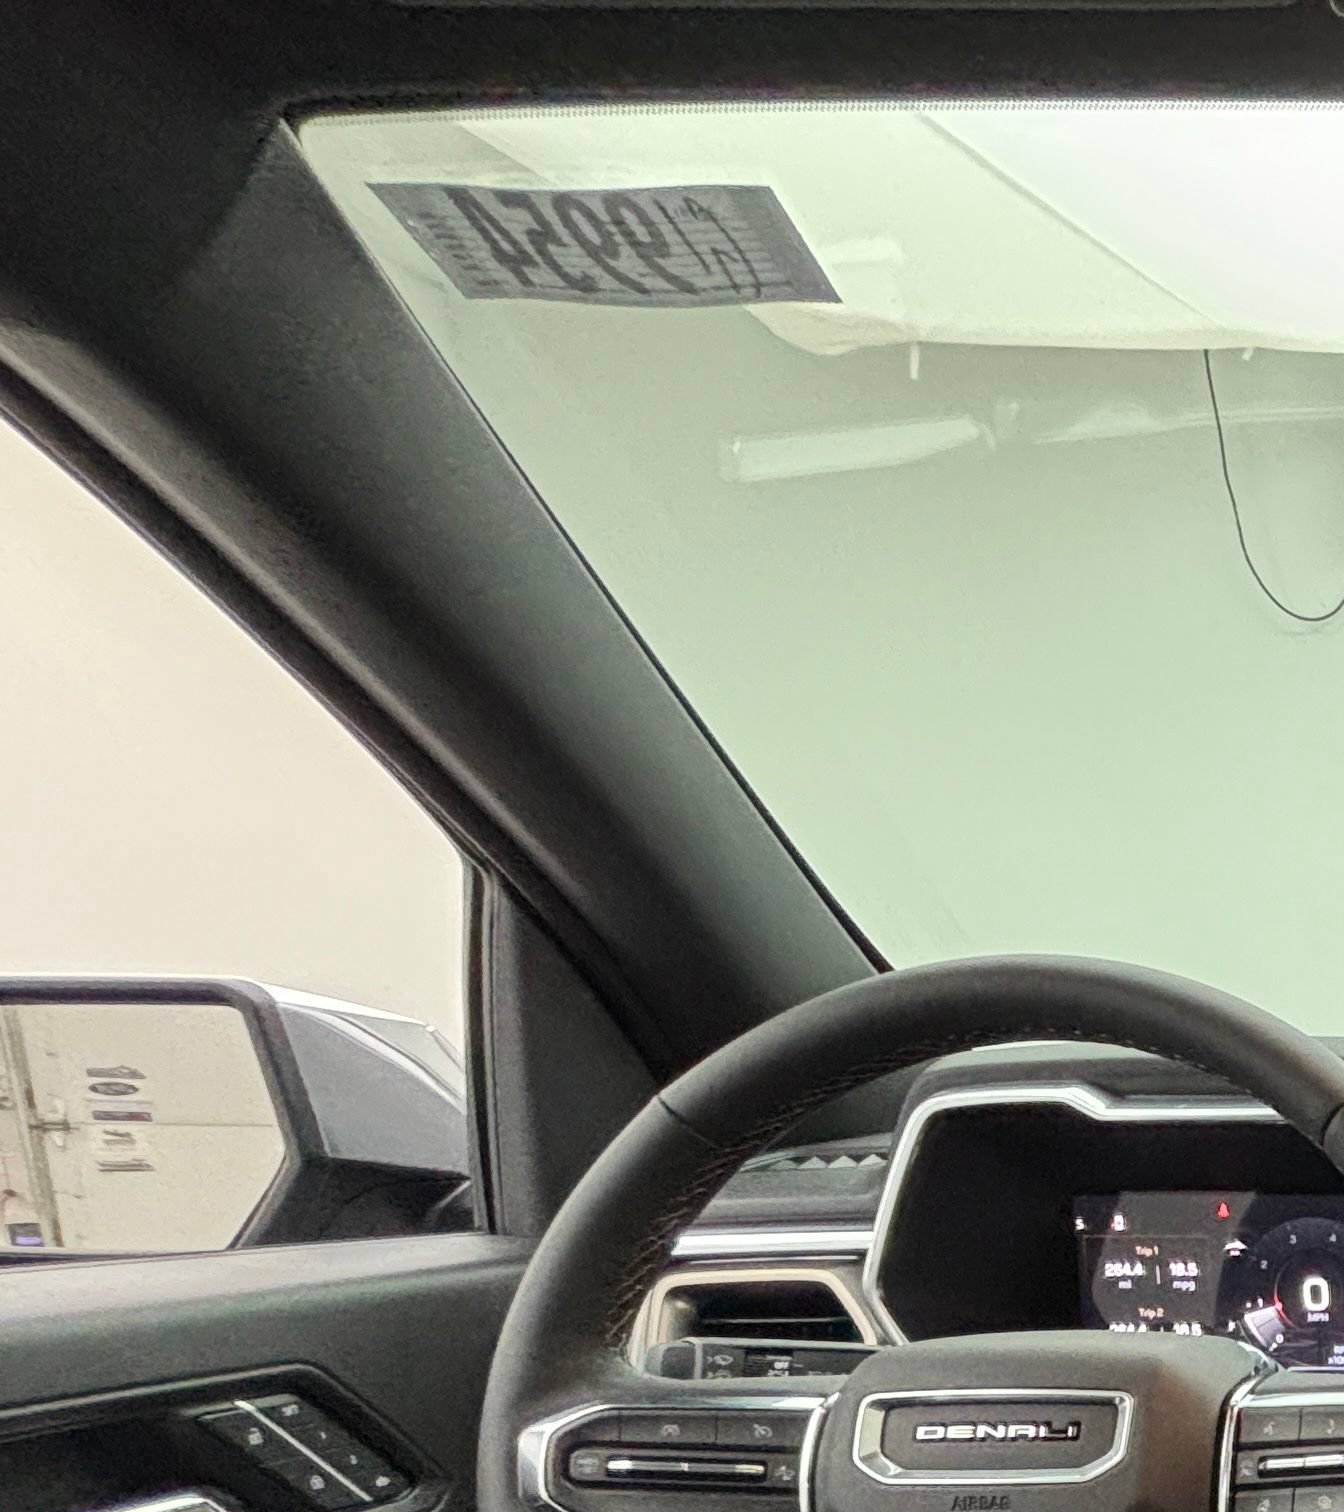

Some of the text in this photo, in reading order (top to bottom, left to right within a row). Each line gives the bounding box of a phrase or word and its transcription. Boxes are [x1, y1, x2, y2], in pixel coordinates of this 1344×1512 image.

[1329, 1234, 1337, 1242] 4
[1136, 1246, 1153, 1257] Trip
[1260, 1260, 1268, 1269] 2
[1172, 1281, 1195, 1291] mpg
[1302, 1276, 1330, 1311] 0
[1138, 1308, 1156, 1319] Trip
[1307, 1312, 1329, 1322] MPH
[915, 1423, 1080, 1440] DENALI
[951, 1496, 1011, 1511] AIRBAG
